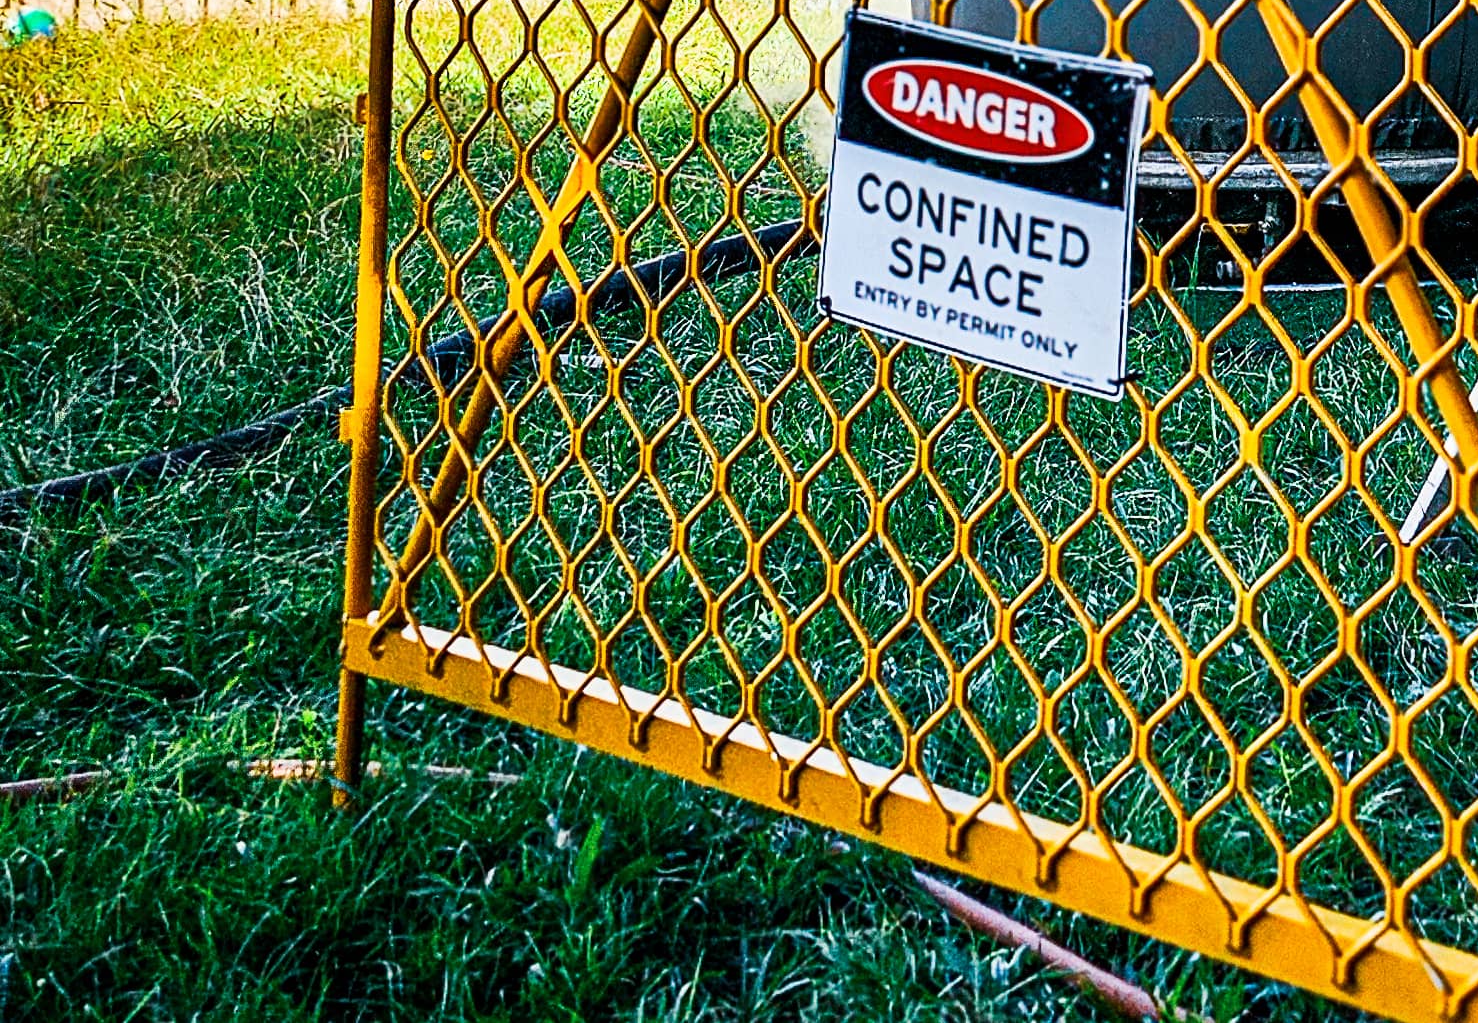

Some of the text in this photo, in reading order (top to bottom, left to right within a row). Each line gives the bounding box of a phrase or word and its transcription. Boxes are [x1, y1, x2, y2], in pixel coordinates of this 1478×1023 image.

[892, 71, 1057, 148] DANGER
[858, 173, 1090, 268] CONFINED
[888, 238, 1044, 316] SPACE
[855, 280, 1078, 359] ENTRY BY PERMIT ONLY
